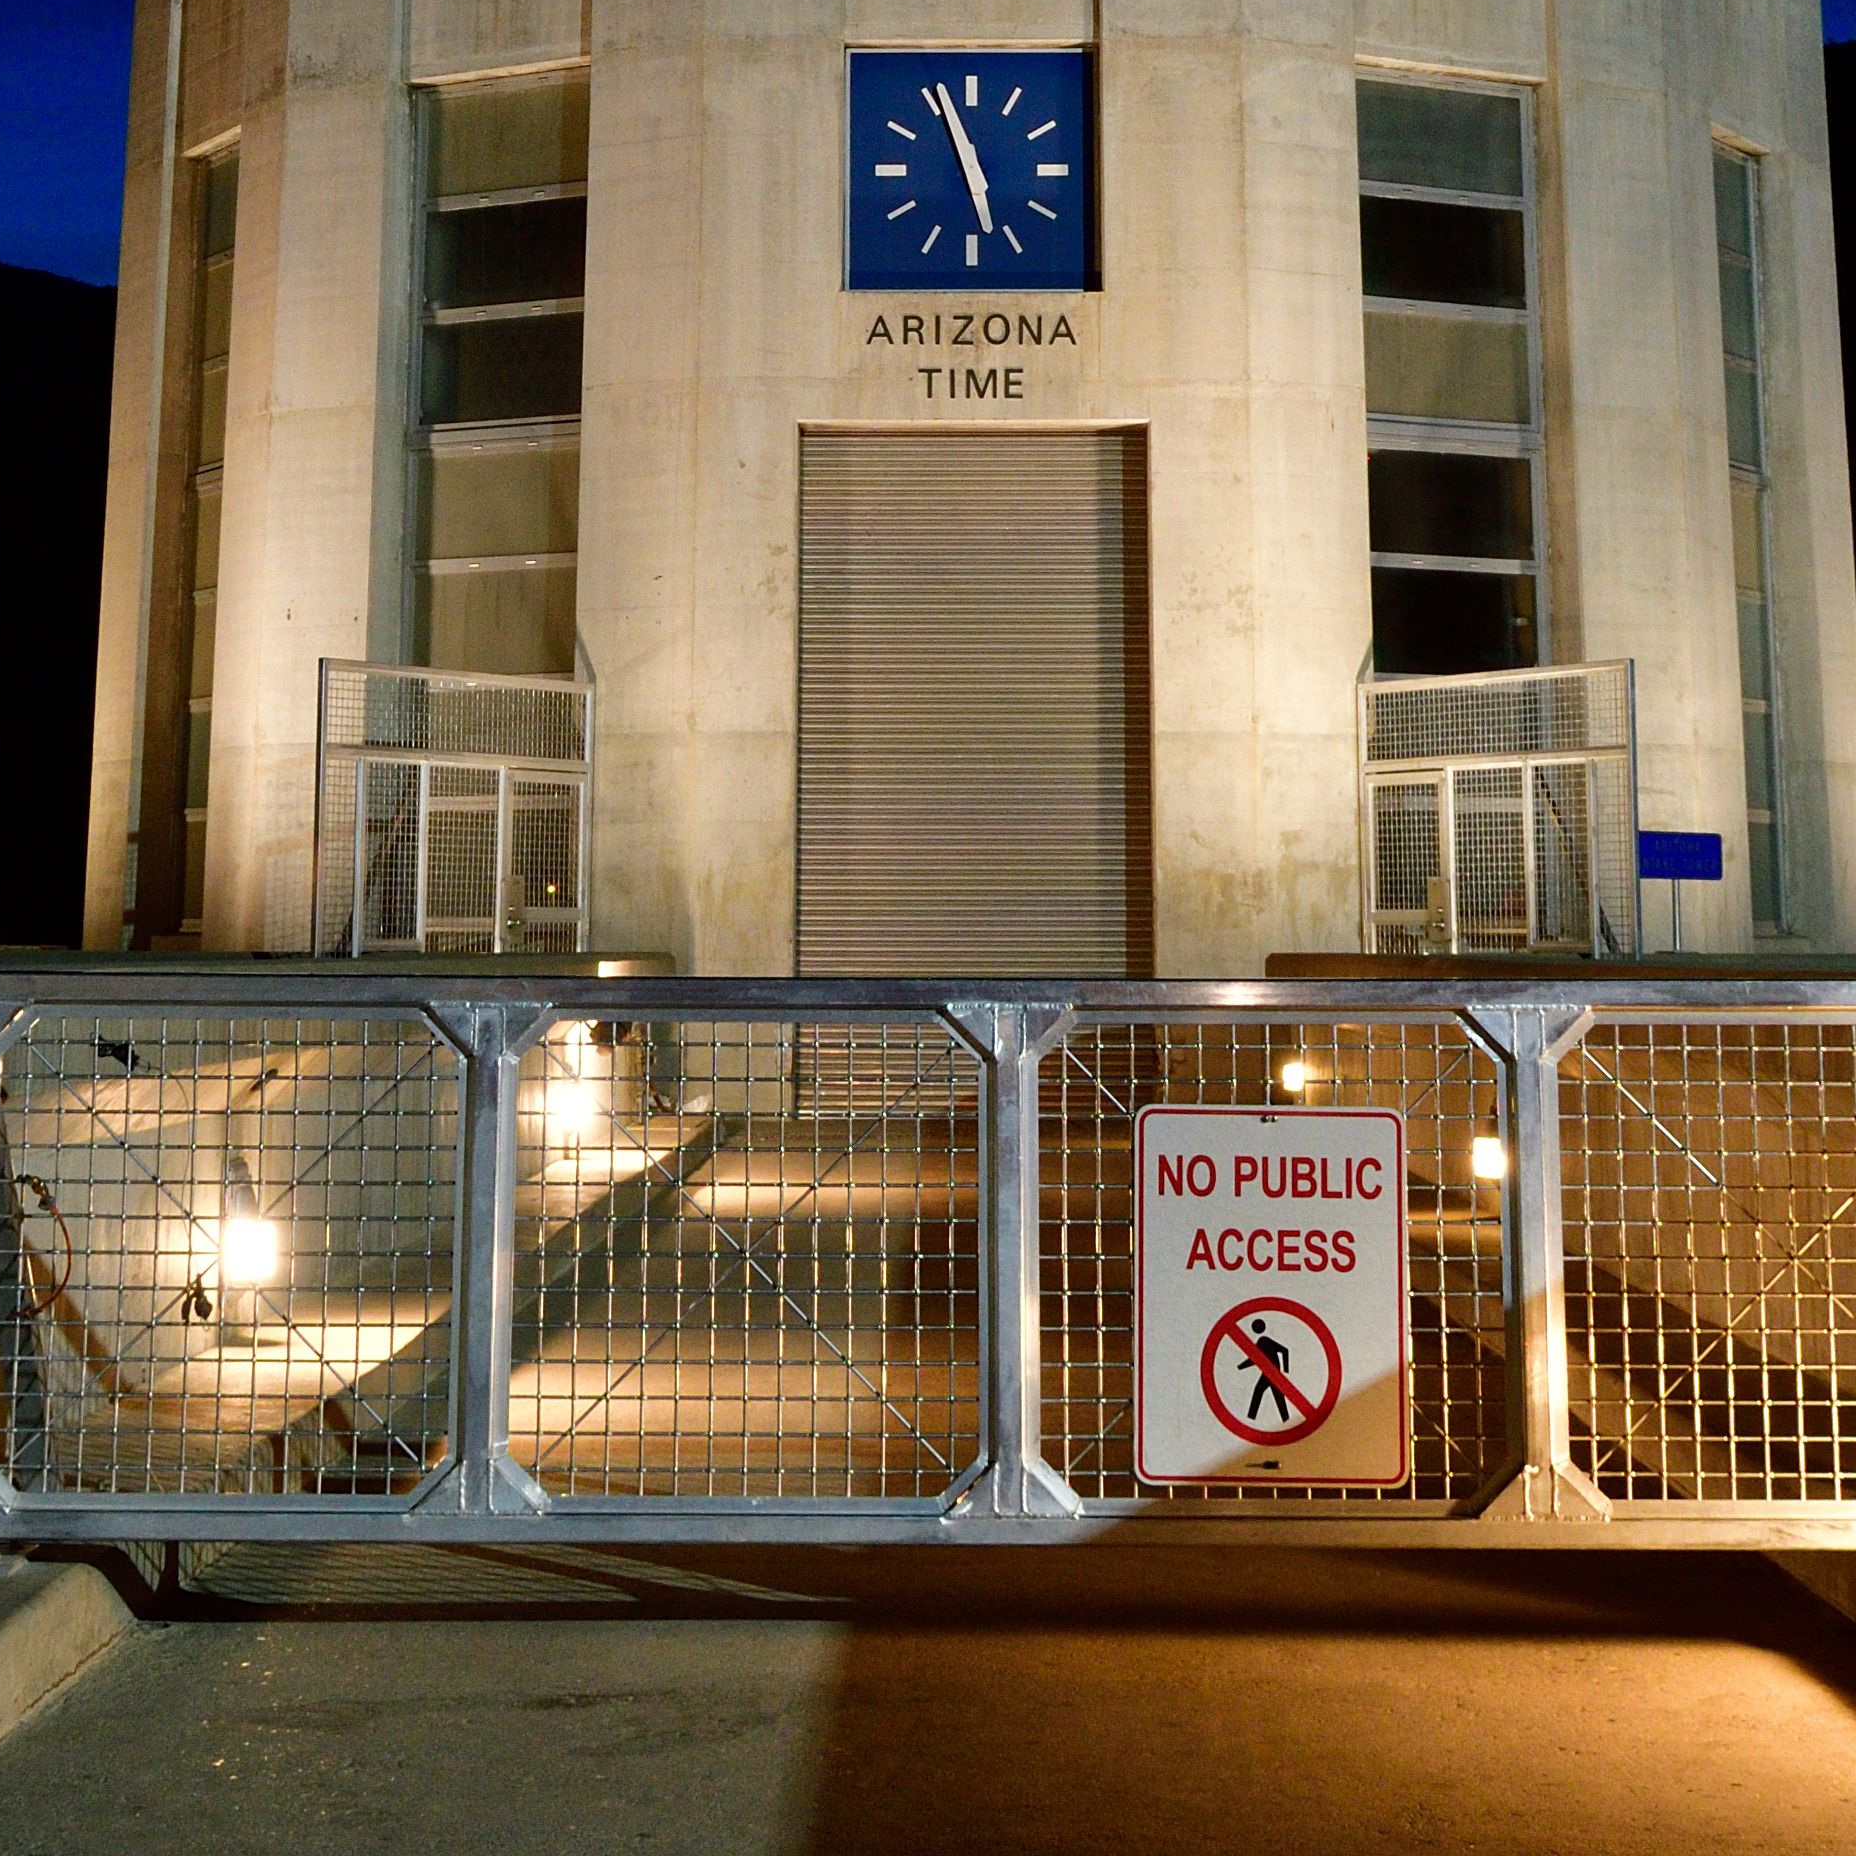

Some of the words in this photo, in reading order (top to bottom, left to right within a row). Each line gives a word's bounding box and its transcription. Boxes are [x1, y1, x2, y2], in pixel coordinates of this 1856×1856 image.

[866, 313, 1077, 346] ARIZONA
[917, 368, 1025, 399] TIME
[1157, 1154, 1217, 1198] NO
[1233, 1155, 1383, 1200] PUBLIC
[1186, 1227, 1357, 1273] ACCESS
